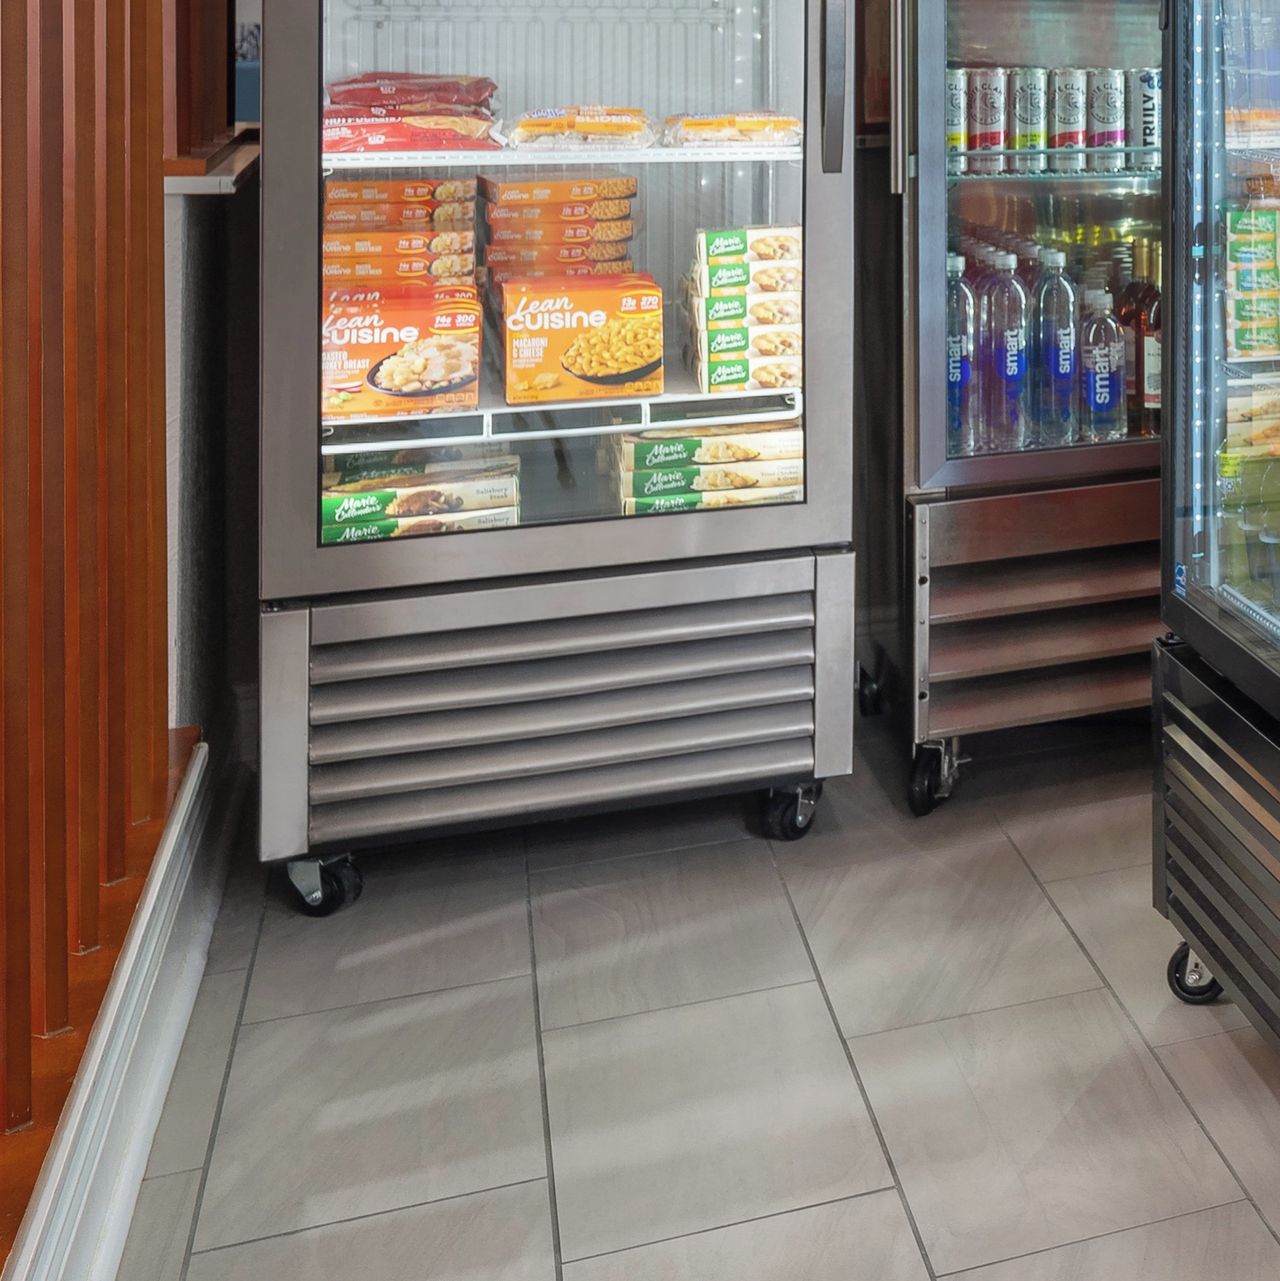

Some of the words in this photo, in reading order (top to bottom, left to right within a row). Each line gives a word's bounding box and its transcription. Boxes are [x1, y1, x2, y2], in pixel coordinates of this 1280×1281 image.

[514, 295, 575, 318] Lean
[641, 296, 660, 307] 270
[456, 314, 475, 323] 300
[512, 337, 548, 349] MACARONI
[520, 347, 545, 359] CHEESE
[1007, 329, 1020, 377] smart
[1059, 327, 1072, 375] smart
[948, 335, 962, 383] smart
[1096, 345, 1111, 405] smart
[651, 443, 686, 458] Marie
[650, 472, 684, 487] Marie
[338, 496, 379, 511] Marie
[339, 524, 380, 540] Marie
